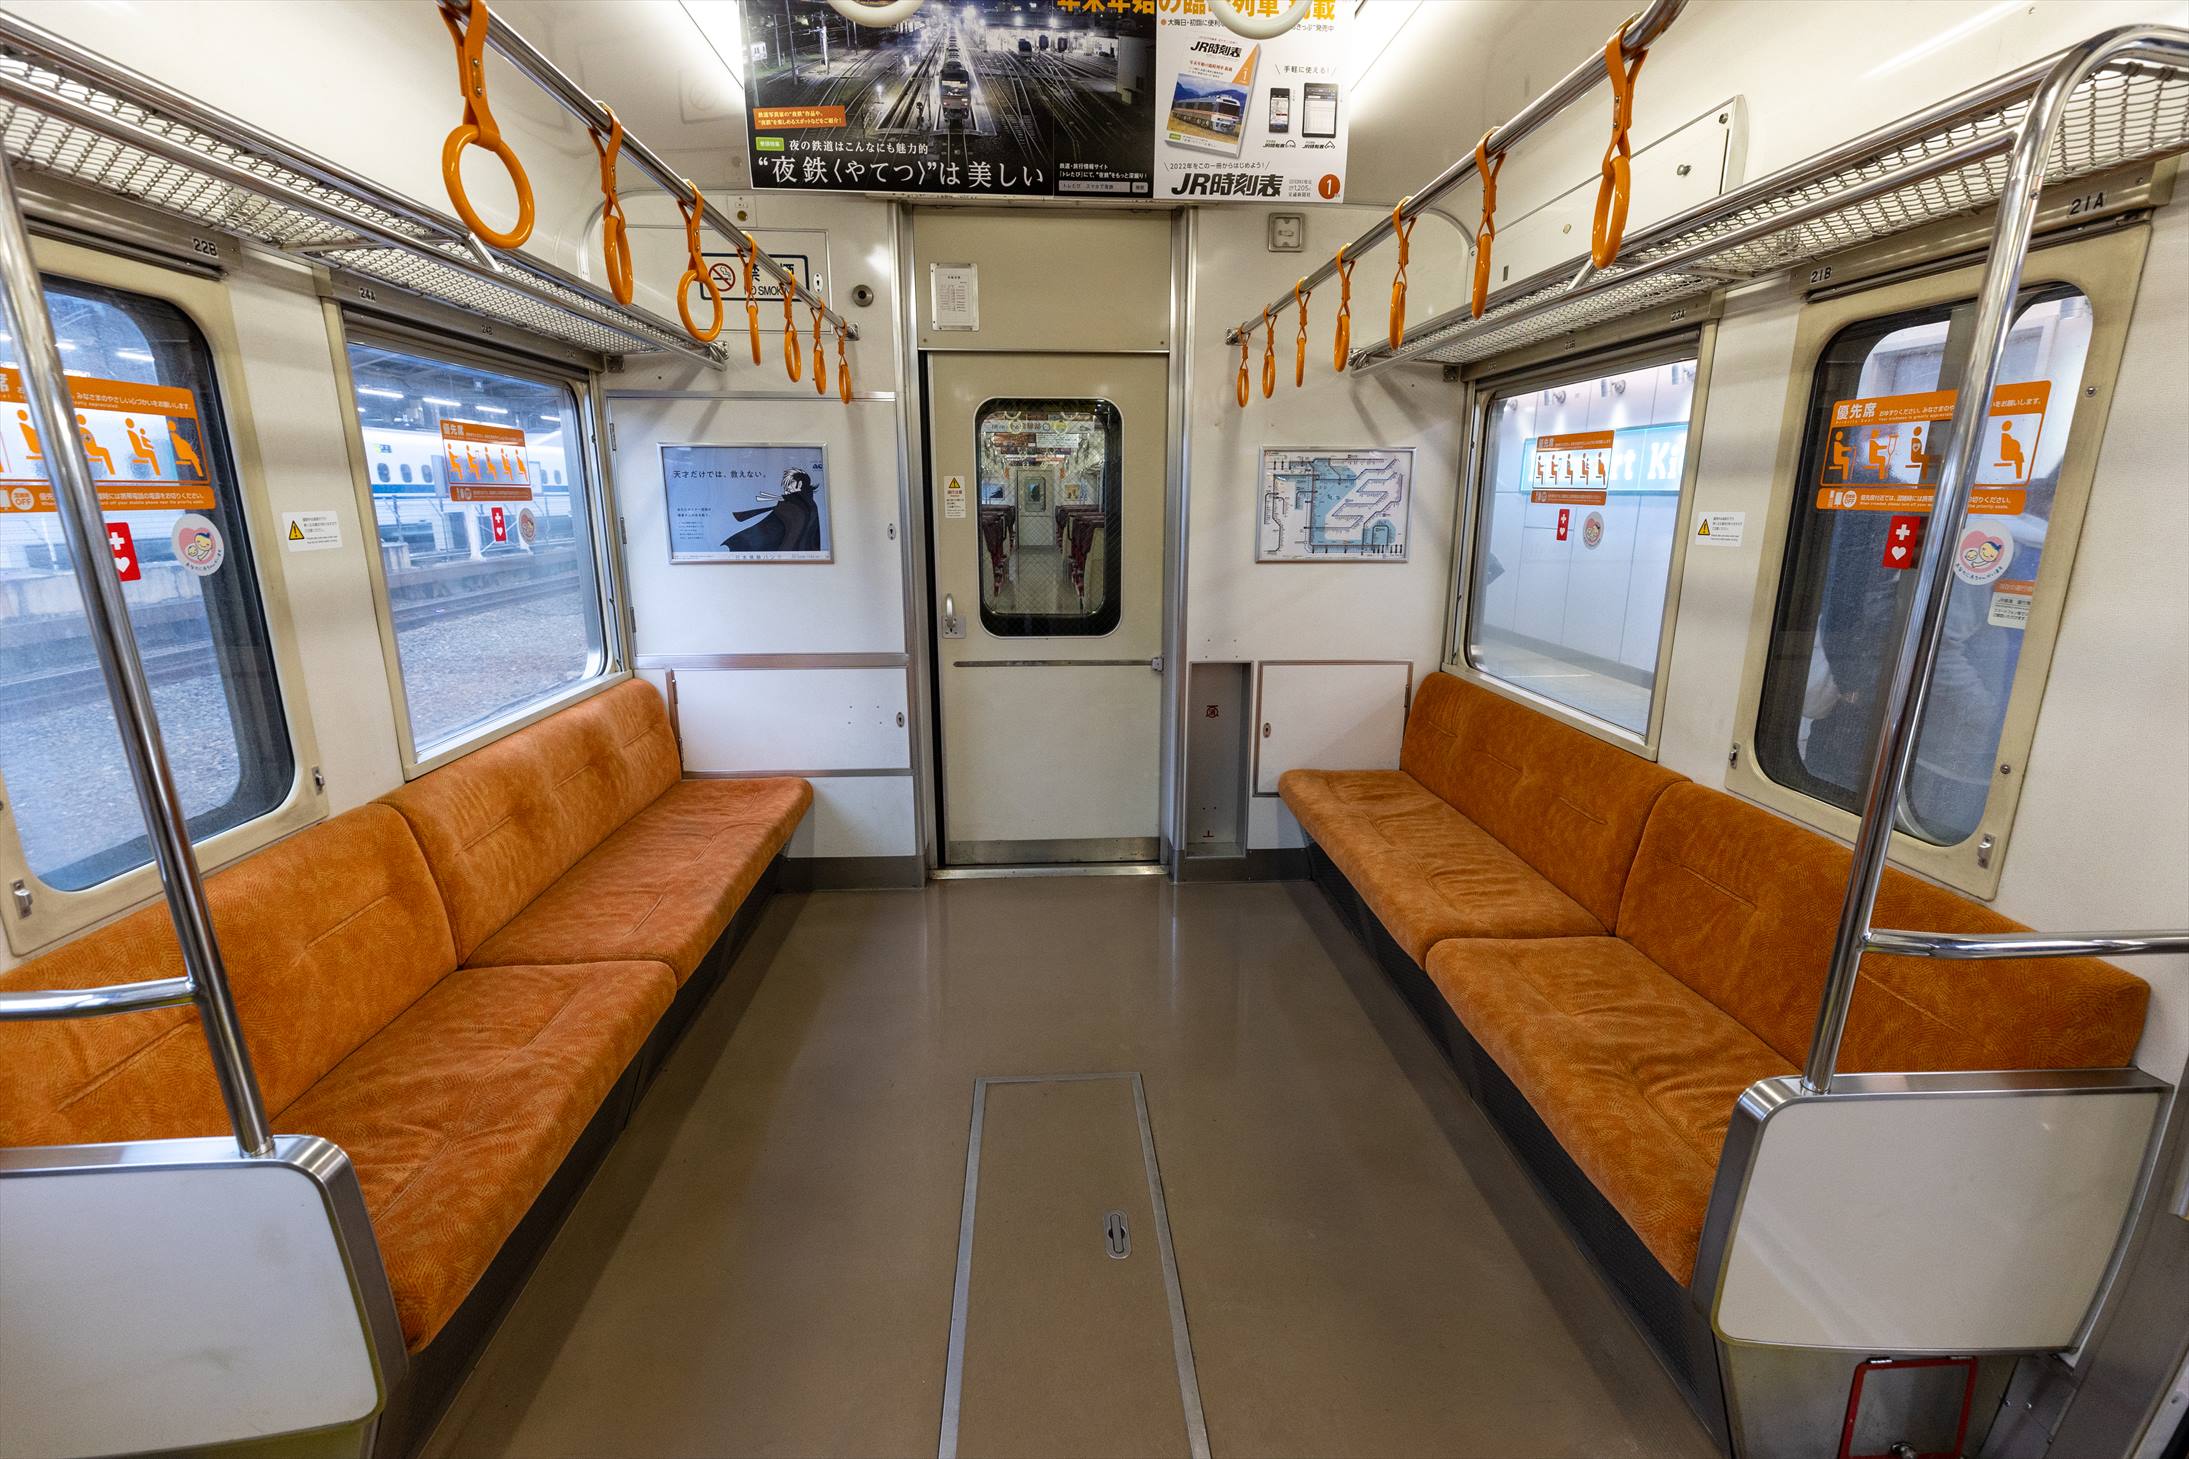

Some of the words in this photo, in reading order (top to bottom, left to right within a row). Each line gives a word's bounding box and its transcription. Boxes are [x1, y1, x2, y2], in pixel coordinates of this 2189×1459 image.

[789, 140, 928, 154] 夜の鉄道はこんなにも魅力的
[1171, 172, 1284, 197] JR時刻表
[2070, 192, 2104, 215] 21A
[193, 238, 218, 257] 22B
[1811, 266, 1833, 283] 21B
[360, 287, 377, 302] 24A
[758, 286, 789, 296] SMOK
[1671, 309, 1686, 322] 23A
[1837, 402, 1877, 420] 優先席
